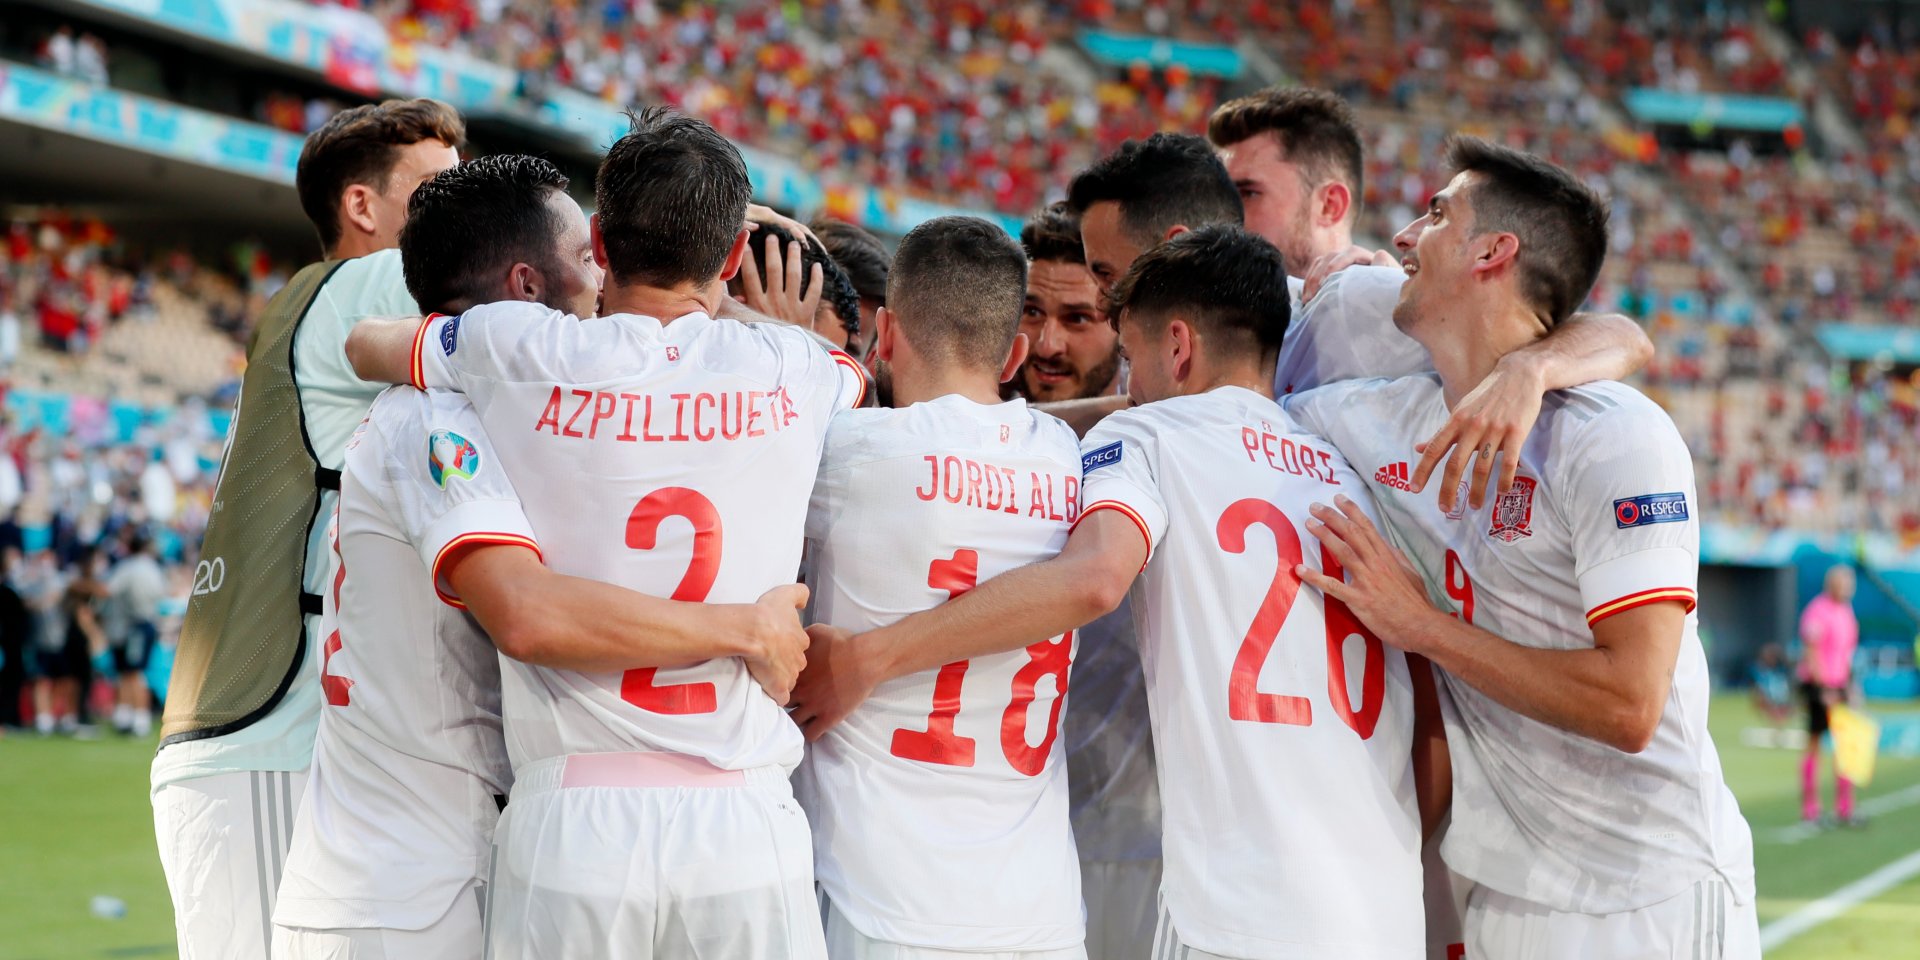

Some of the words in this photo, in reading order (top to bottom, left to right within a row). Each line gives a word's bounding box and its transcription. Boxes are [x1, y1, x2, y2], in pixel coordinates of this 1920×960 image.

[445, 319, 455, 354] PECT
[1083, 448, 1121, 469] SPECT
[1242, 427, 1341, 485] PEDRI
[1375, 472, 1410, 492] adidas
[916, 455, 1019, 515] JORDI
[1028, 472, 1082, 523] ALB
[1641, 501, 1686, 516] RESPECT
[621, 486, 723, 715] 2
[1216, 497, 1385, 740] 26
[890, 548, 1072, 776] 18
